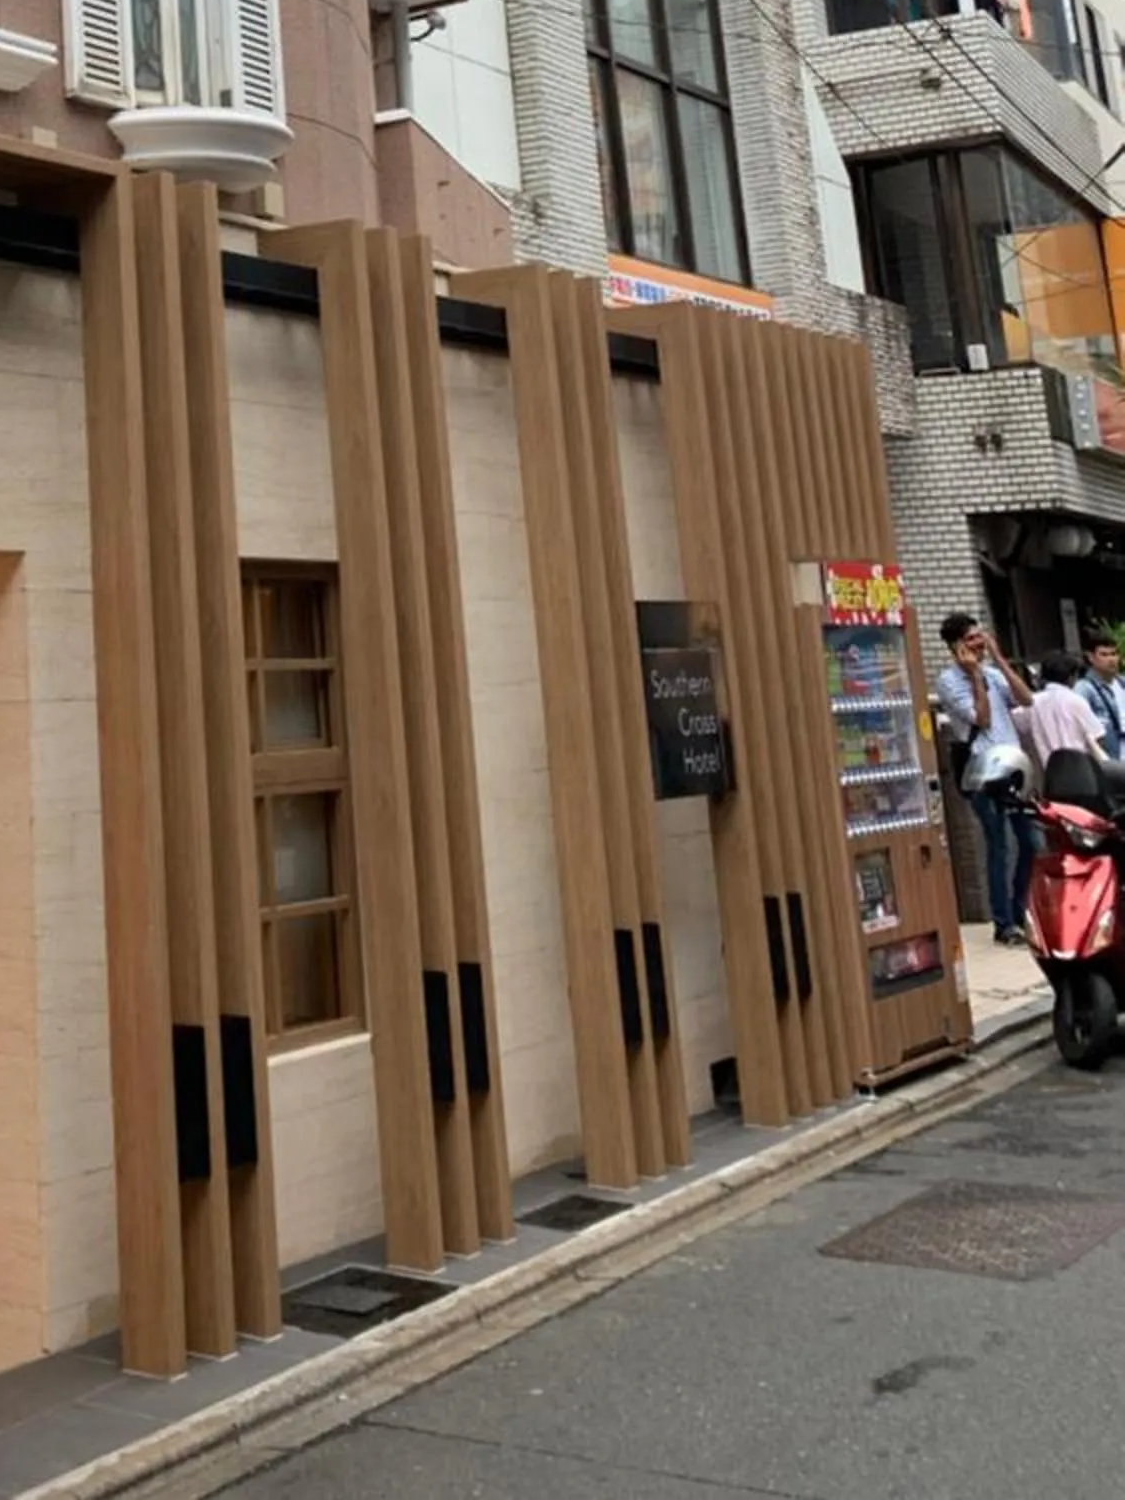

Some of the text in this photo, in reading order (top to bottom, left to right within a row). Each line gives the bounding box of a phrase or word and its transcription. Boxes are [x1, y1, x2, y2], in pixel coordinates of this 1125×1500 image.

[650, 668, 713, 699] Southern
[677, 707, 718, 737] Cross
[683, 747, 721, 775] Hotel
